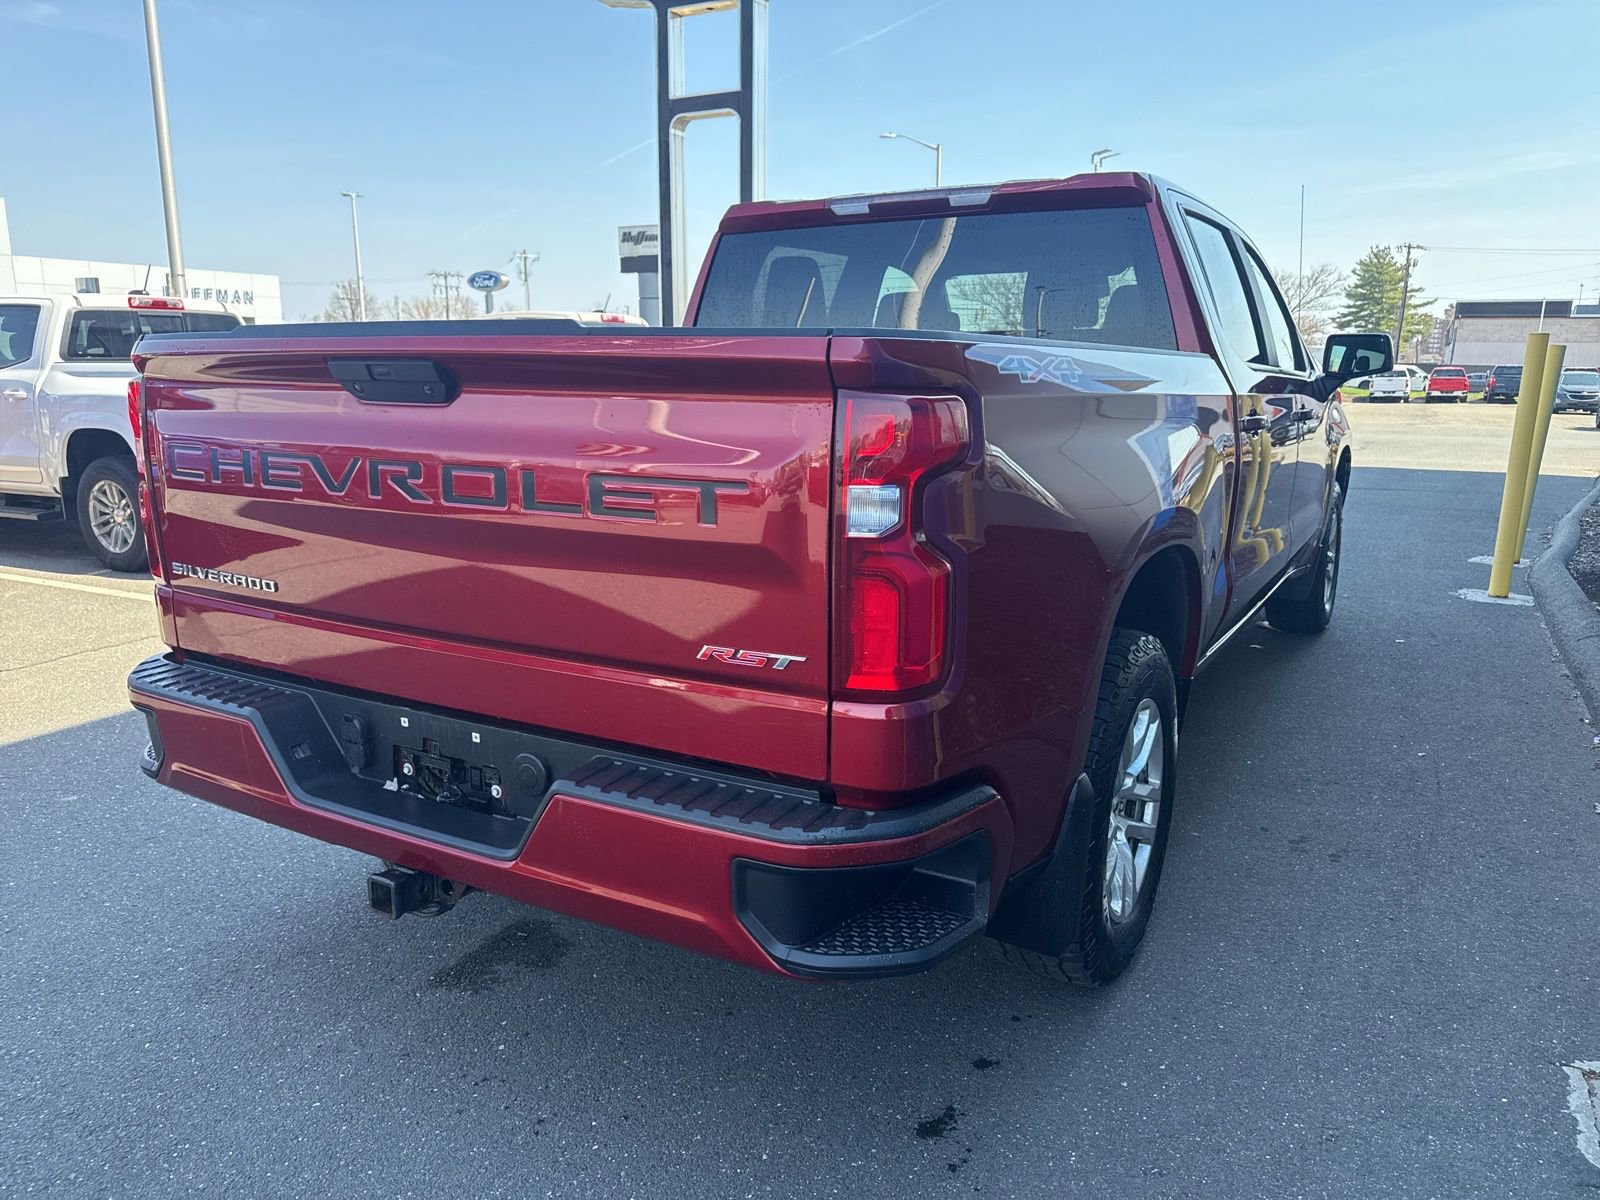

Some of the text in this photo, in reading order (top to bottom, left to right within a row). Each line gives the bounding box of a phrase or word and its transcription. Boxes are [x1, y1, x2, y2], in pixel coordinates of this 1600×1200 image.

[162, 286, 254, 304] FFMAN
[168, 442, 750, 528] CHEVROLET
[171, 562, 279, 593] SILVERADO
[696, 644, 807, 670] RST
